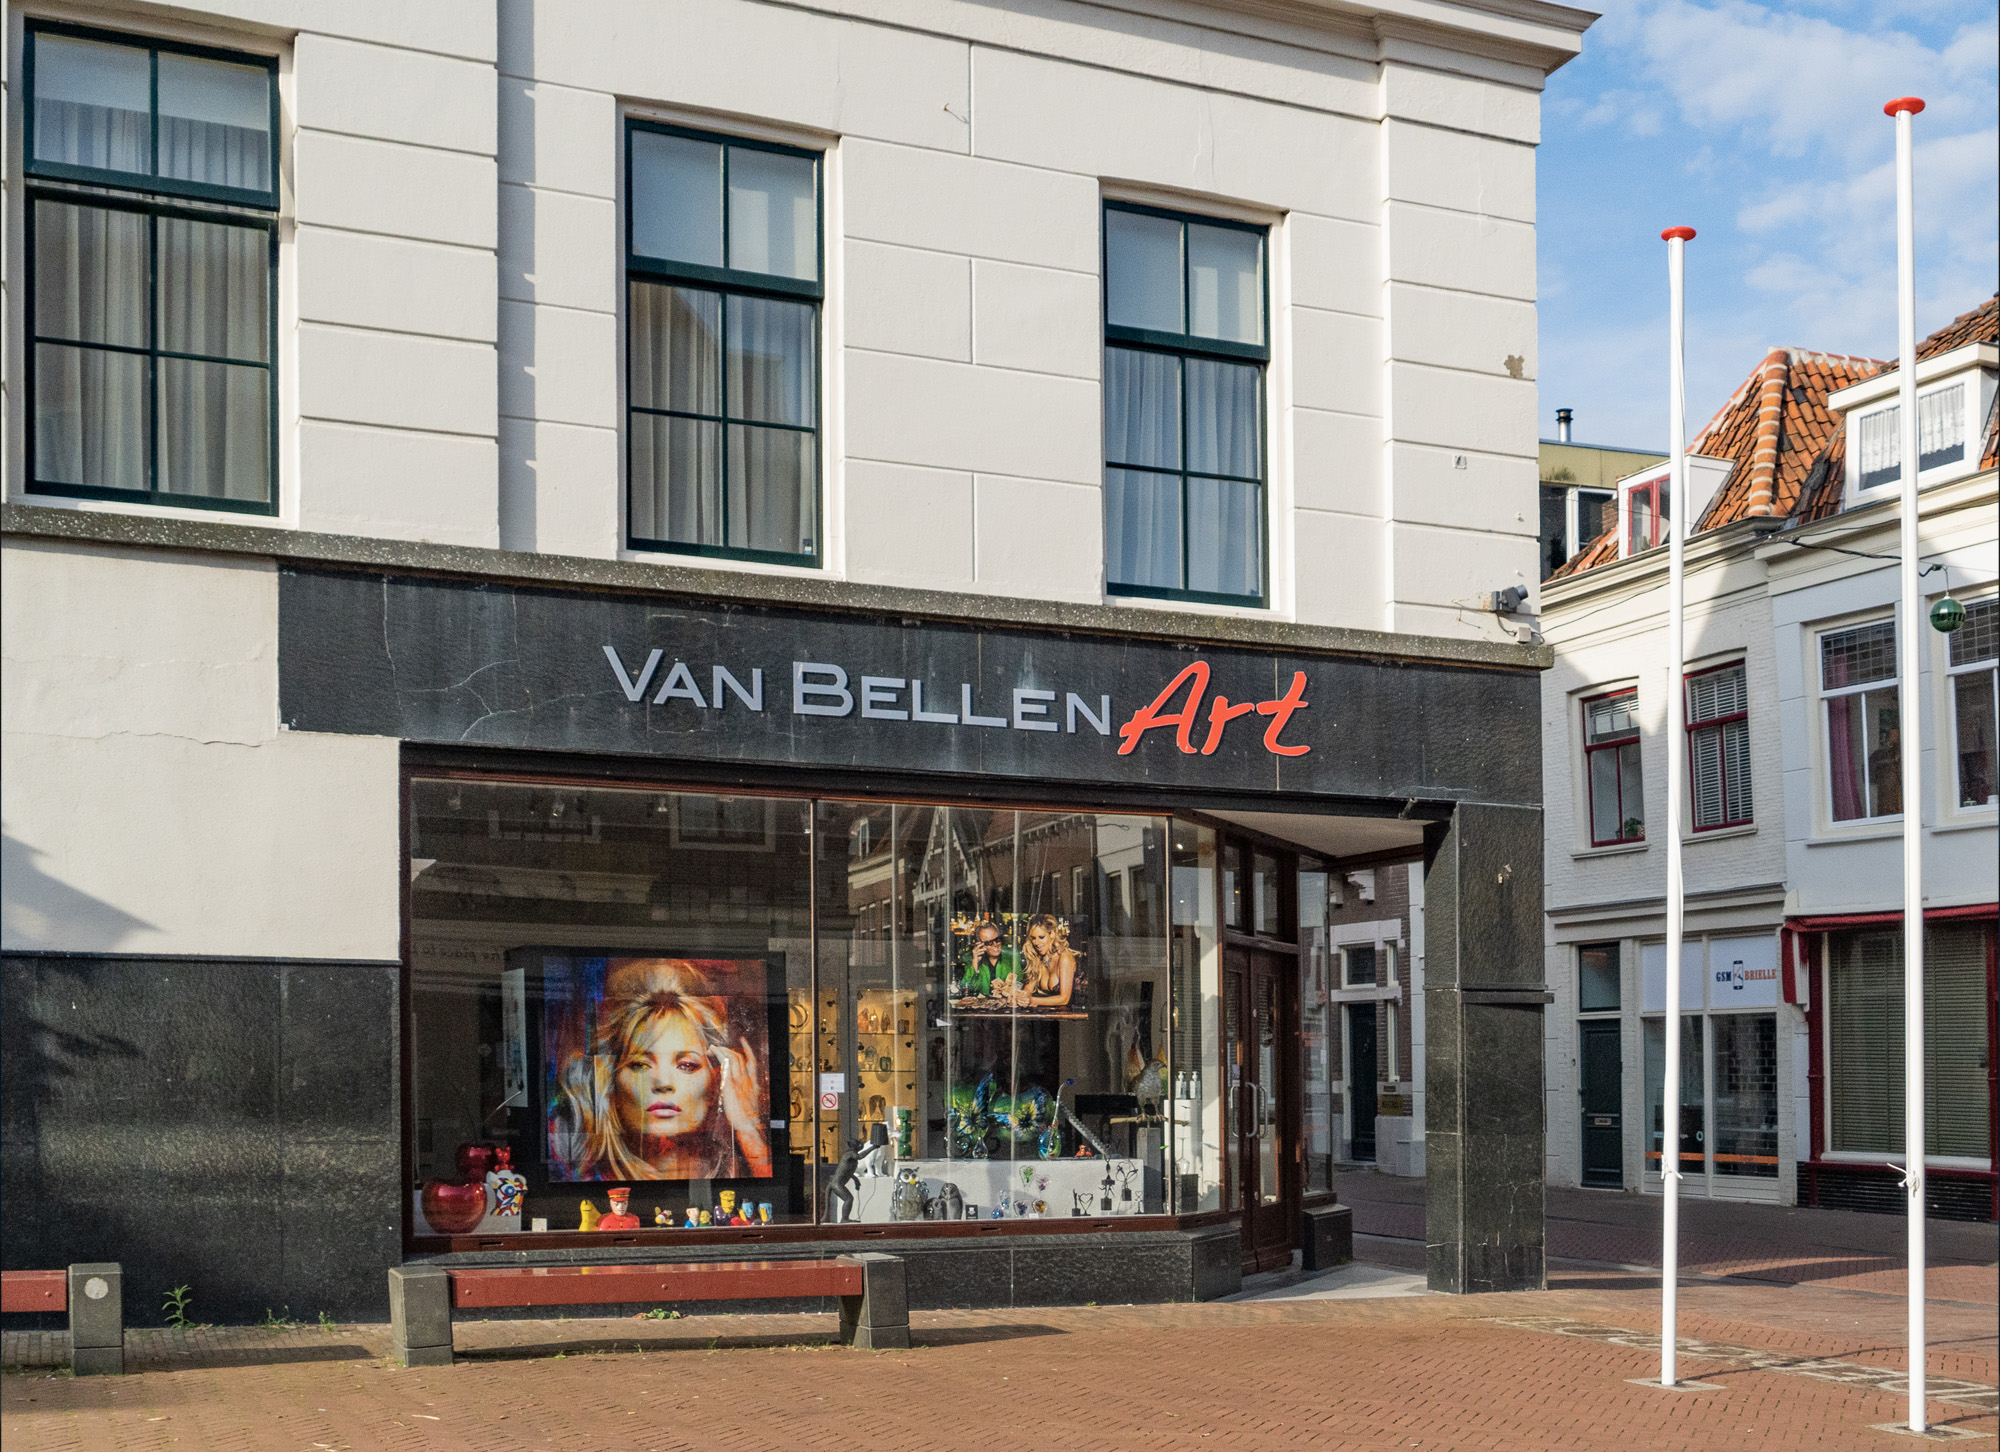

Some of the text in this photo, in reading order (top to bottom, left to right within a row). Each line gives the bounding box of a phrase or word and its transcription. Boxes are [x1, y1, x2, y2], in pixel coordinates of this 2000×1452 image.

[602, 645, 1311, 756] VAN BELLEN Art
[1716, 969, 1776, 982] GSM BRIELLE
